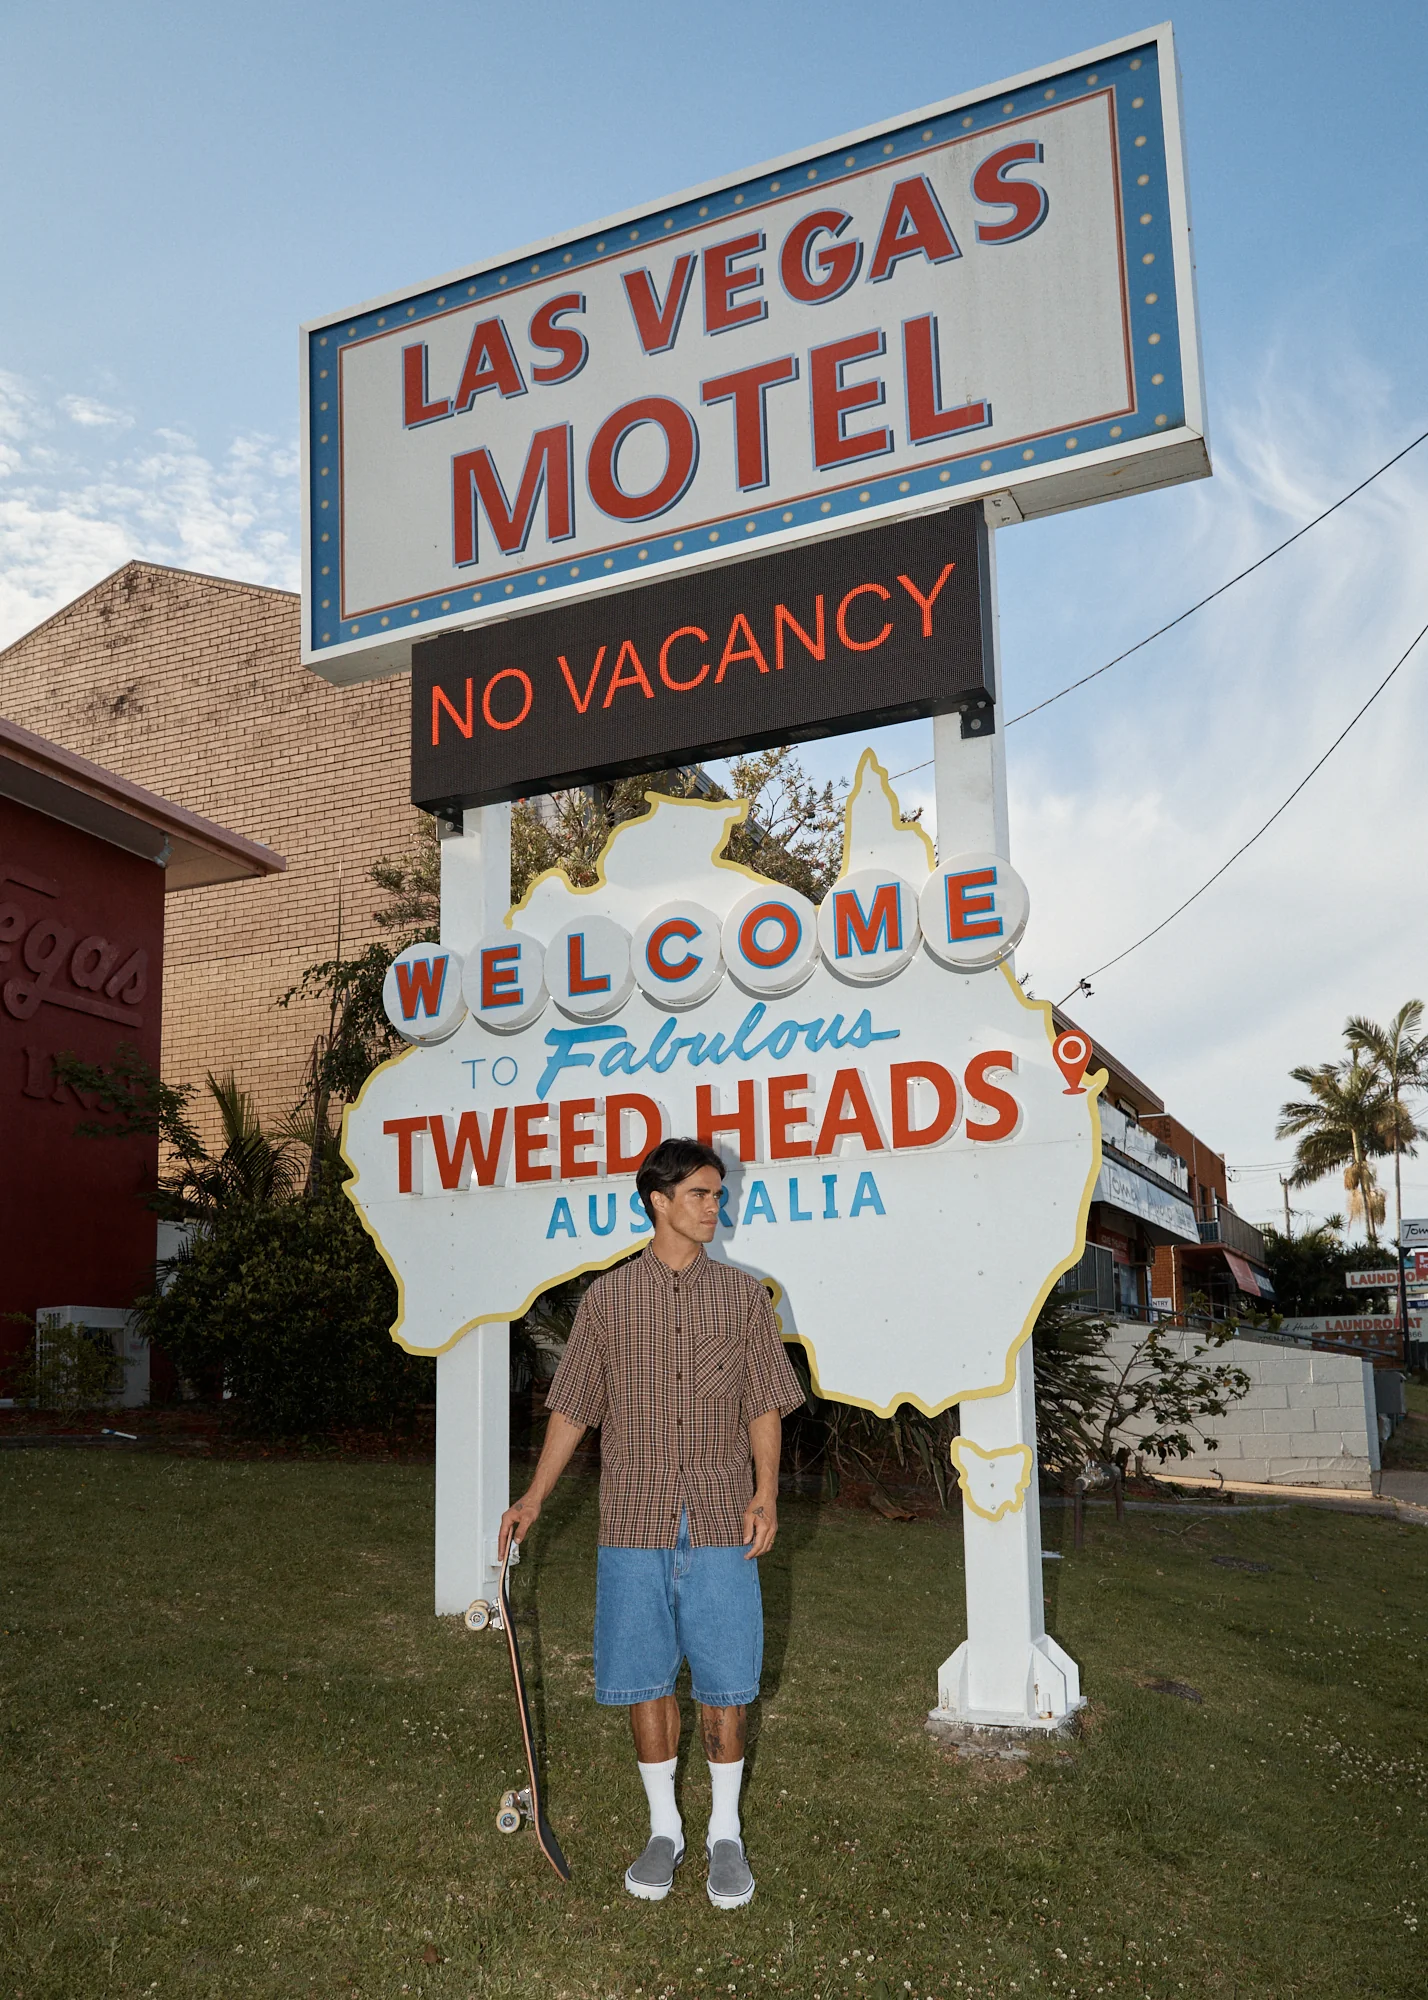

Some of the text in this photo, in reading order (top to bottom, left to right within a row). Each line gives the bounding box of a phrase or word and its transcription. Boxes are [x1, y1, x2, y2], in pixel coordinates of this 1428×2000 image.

[401, 140, 1049, 430] LAS VEGAS
[451, 312, 992, 568] MOTEL
[431, 562, 955, 746] NO VACANCY
[394, 866, 1003, 1022] WELCOME
[382, 1050, 1023, 1195] TWEED HEADS
[461, 1002, 901, 1101] TO Fabulous
[546, 1171, 886, 1239] AUSRALIA
